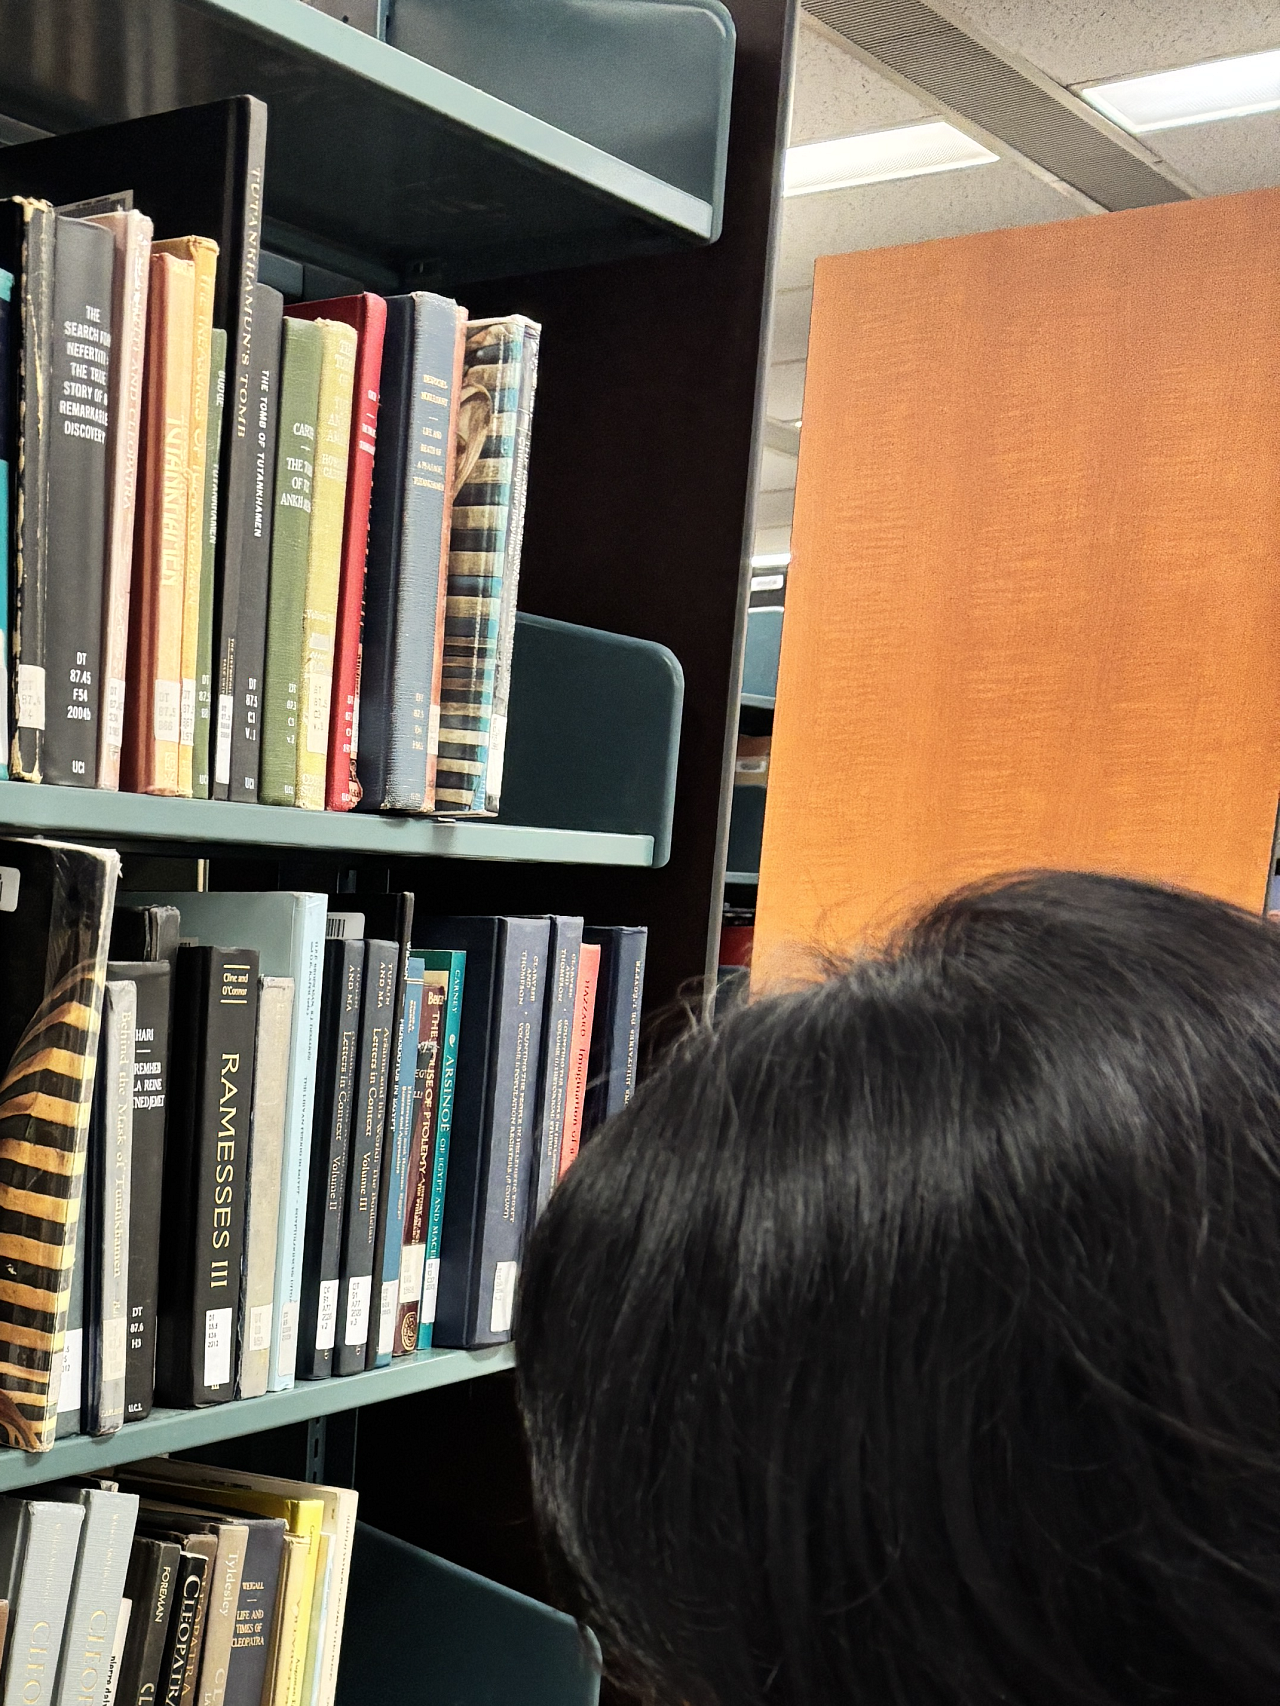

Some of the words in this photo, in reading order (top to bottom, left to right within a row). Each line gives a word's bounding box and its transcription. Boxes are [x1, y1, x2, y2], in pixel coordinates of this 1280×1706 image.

[85, 305, 101, 322] THE
[64, 321, 100, 345] SEARCH
[70, 362, 88, 379] THE
[262, 370, 270, 391] THE
[63, 381, 93, 399] STORY
[236, 374, 249, 437] TOMB
[260, 397, 269, 428] TOMB
[259, 432, 267, 448] OF
[76, 651, 87, 666] DT
[119, 1011, 132, 1066] Behind
[342, 1031, 352, 1072] Letters
[369, 1029, 381, 1068] Letters
[118, 1071, 130, 1096] the
[143, 1079, 162, 1092] REINE
[439, 1055, 455, 1133] ARSINOË
[116, 1103, 128, 1145] Mask
[336, 1091, 349, 1141] Context
[366, 1082, 378, 1137] Context
[116, 1152, 127, 1168] of
[213, 1053, 240, 1249] RAMESSES
[419, 1112, 432, 1174] PTOLEMY
[329, 1156, 341, 1200] Volume
[361, 1151, 372, 1196] Volume
[210, 1260, 230, 1288] III
[132, 1307, 143, 1318] DT
[154, 1566, 171, 1623] FOREMAN
[218, 1551, 239, 1618] Tyldesley
[236, 1623, 253, 1634] TIMES
[254, 1623, 263, 1633] OF
